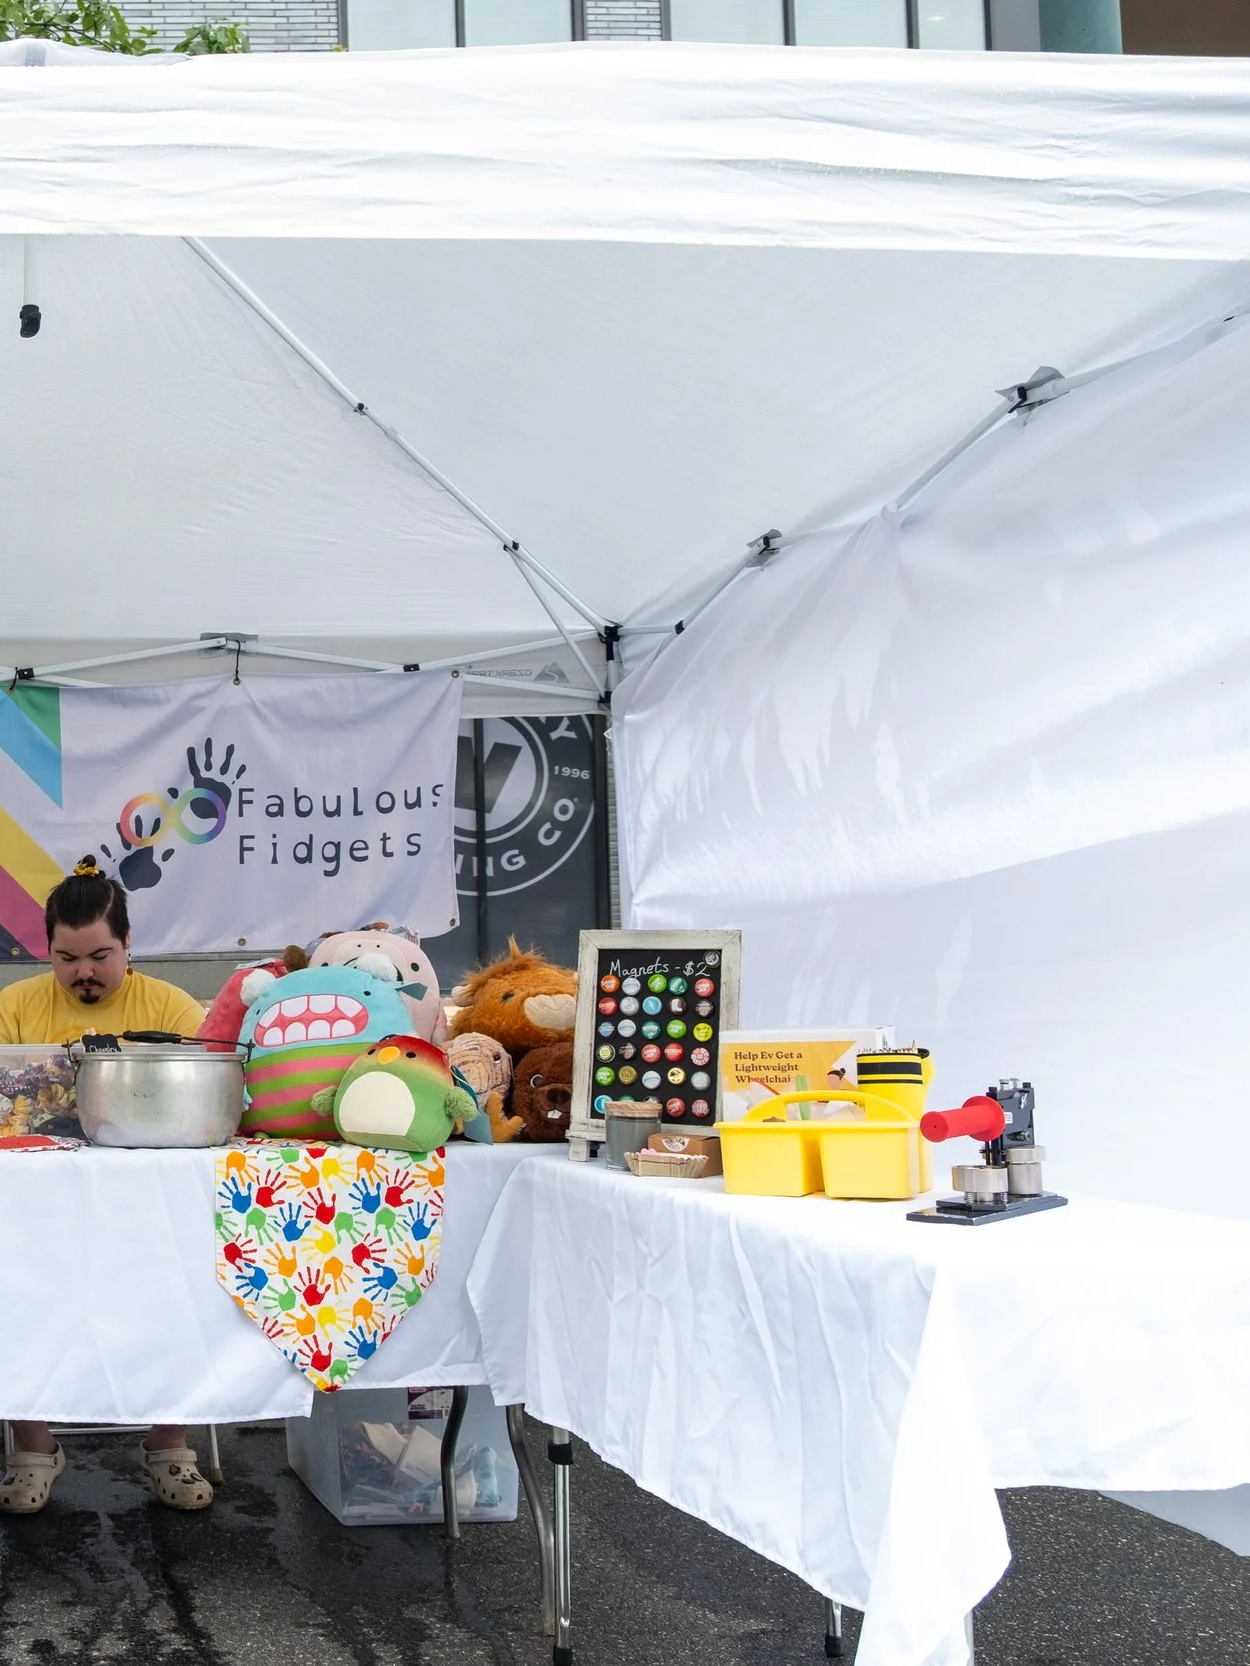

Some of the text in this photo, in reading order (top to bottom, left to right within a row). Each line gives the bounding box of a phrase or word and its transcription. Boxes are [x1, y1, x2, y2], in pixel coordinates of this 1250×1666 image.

[554, 765, 591, 780] 1996
[239, 832, 422, 877] Fidgets
[610, 956, 669, 978] Magnets
[734, 1051, 803, 1062] Help Ev Get a
[735, 1063, 799, 1073] Lightweight
[735, 1074, 791, 1084] Wheelchai
